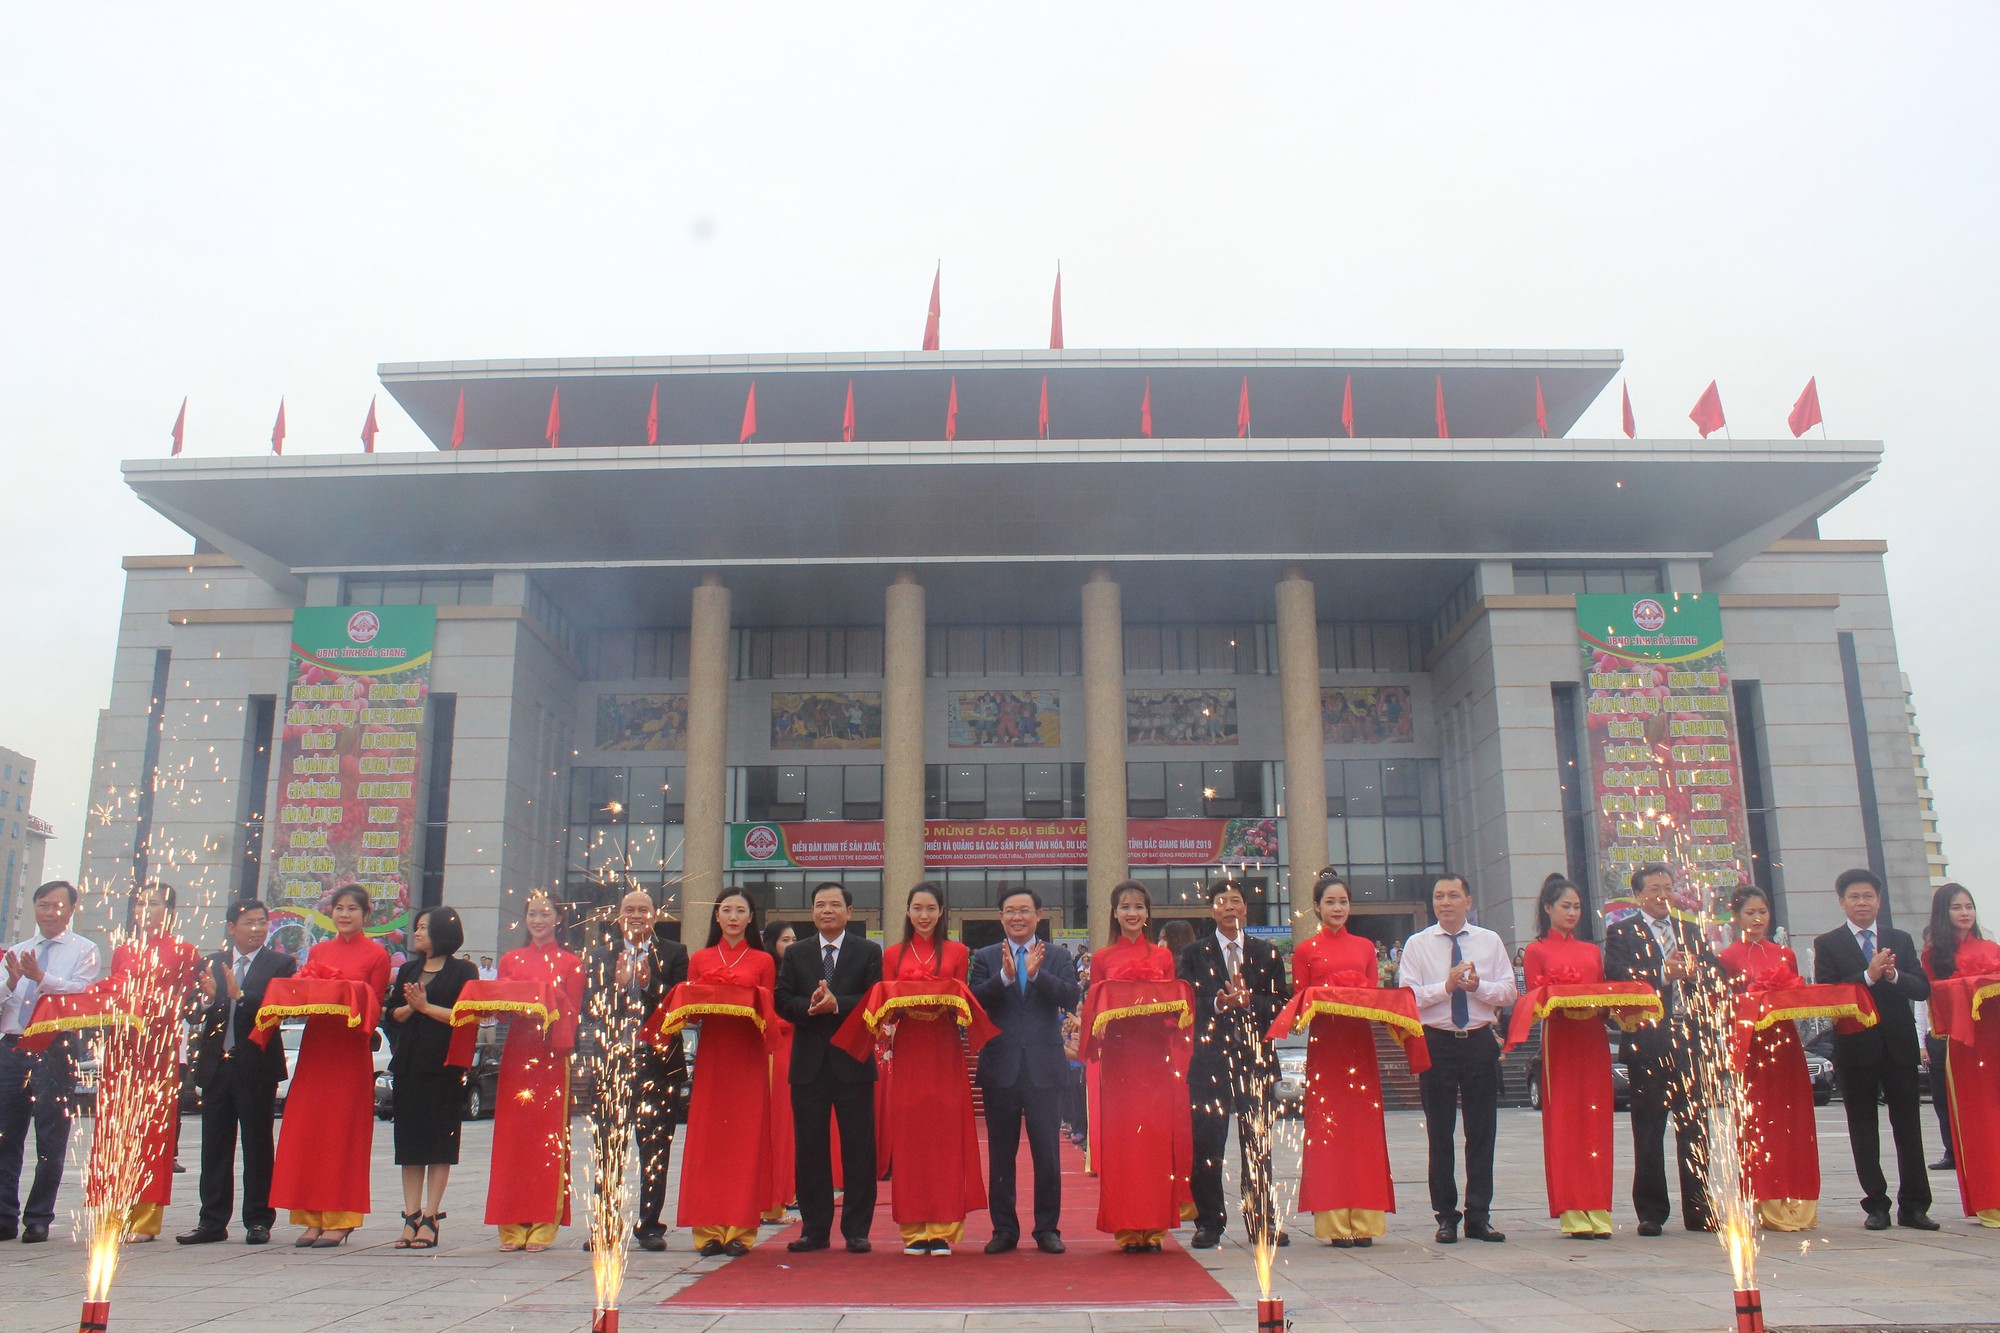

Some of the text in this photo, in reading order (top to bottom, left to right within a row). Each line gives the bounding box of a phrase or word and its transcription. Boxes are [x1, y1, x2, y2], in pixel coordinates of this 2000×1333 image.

[1606, 636, 1630, 645] UBND
[1653, 633, 1670, 645] BẮC
[1671, 636, 1698, 645] GIANG
[316, 645, 406, 658] UBND TỈNH BẮC GIANG
[934, 825, 974, 836] MỪNG
[979, 825, 1005, 835] CÁC
[1010, 827, 1032, 837] ĐẠI
[1036, 823, 1065, 835] BIỂU
[1070, 822, 1086, 834] VỀ
[792, 840, 807, 852] DIỄN
[808, 841, 822, 852] ĐÀN
[823, 843, 838, 852] KINH
[840, 840, 848, 852] TẾ
[849, 840, 862, 852] SẢN
[863, 840, 881, 852] XUẤT,
[943, 841, 951, 851] VÀ
[952, 839, 974, 851] QUẢNG
[976, 840, 984, 851] BÁ
[985, 840, 999, 851] CÁC
[1000, 838, 1014, 850] SẢN
[1015, 838, 1034, 850] PHẨM
[1036, 839, 1049, 850] VĂN
[1050, 838, 1065, 850] HÓA,
[1066, 840, 1075, 849] DU
[1076, 840, 1087, 851] LỊC
[1128, 837, 1143, 849] TỈNH
[1144, 837, 1157, 849] BẮC
[1158, 840, 1178, 849] GIANG
[1180, 839, 1195, 849] NĂM
[1196, 840, 1212, 849] 2019
